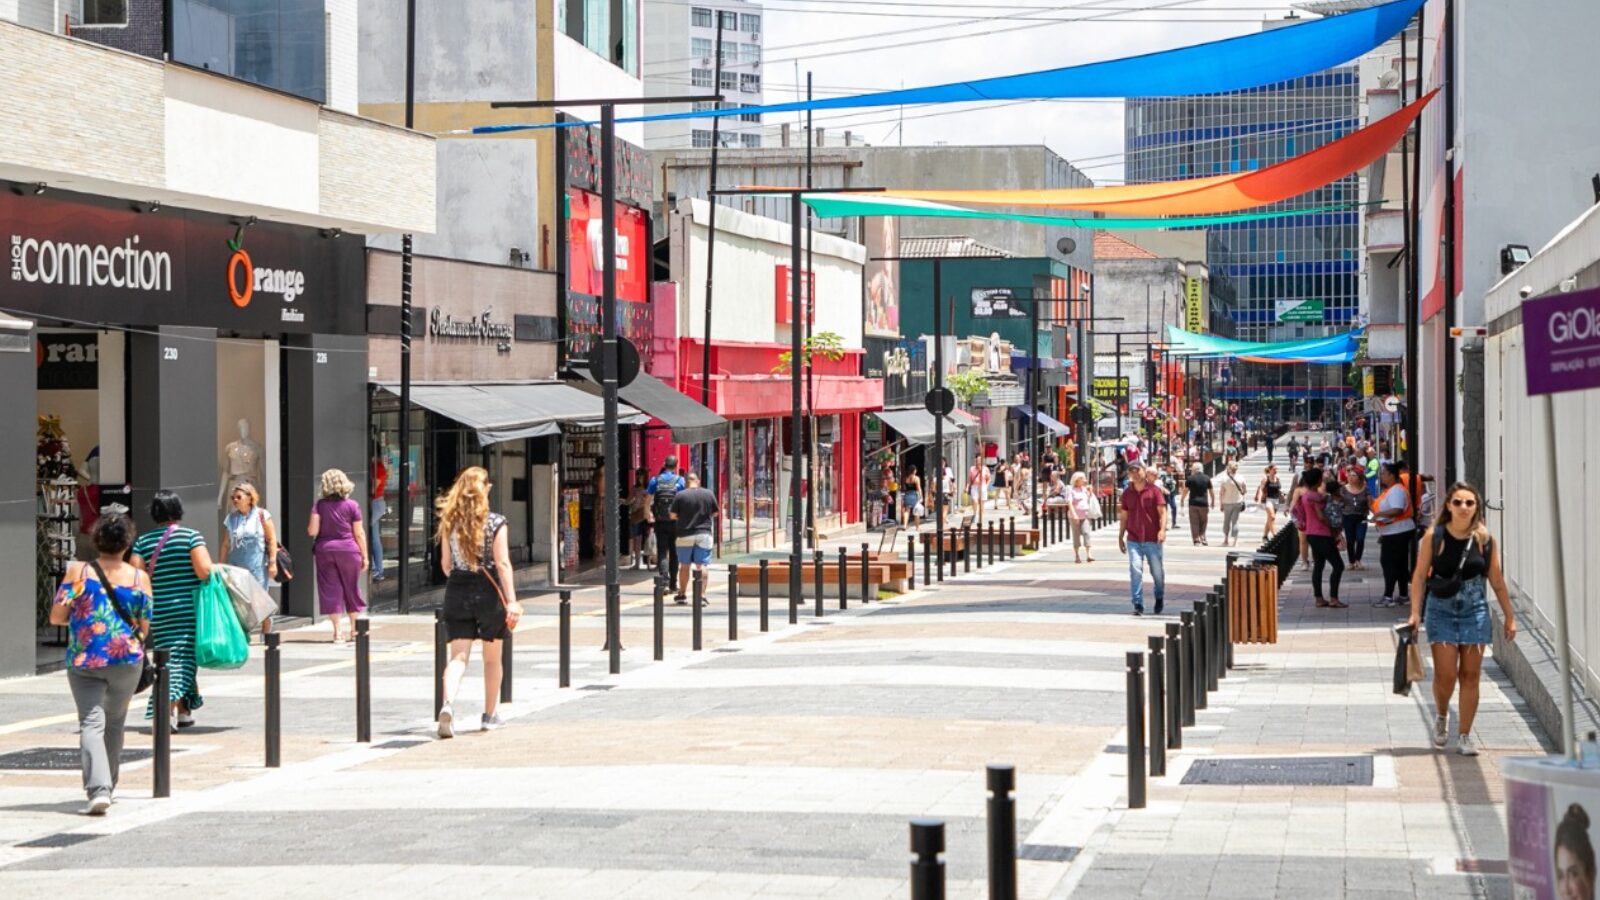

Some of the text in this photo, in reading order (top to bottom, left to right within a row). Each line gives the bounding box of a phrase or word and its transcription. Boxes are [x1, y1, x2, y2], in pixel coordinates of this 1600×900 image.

[11, 235, 22, 280] SHOE
[21, 234, 171, 291] connection
[228, 249, 304, 308] Orange
[164, 346, 178, 360] 230
